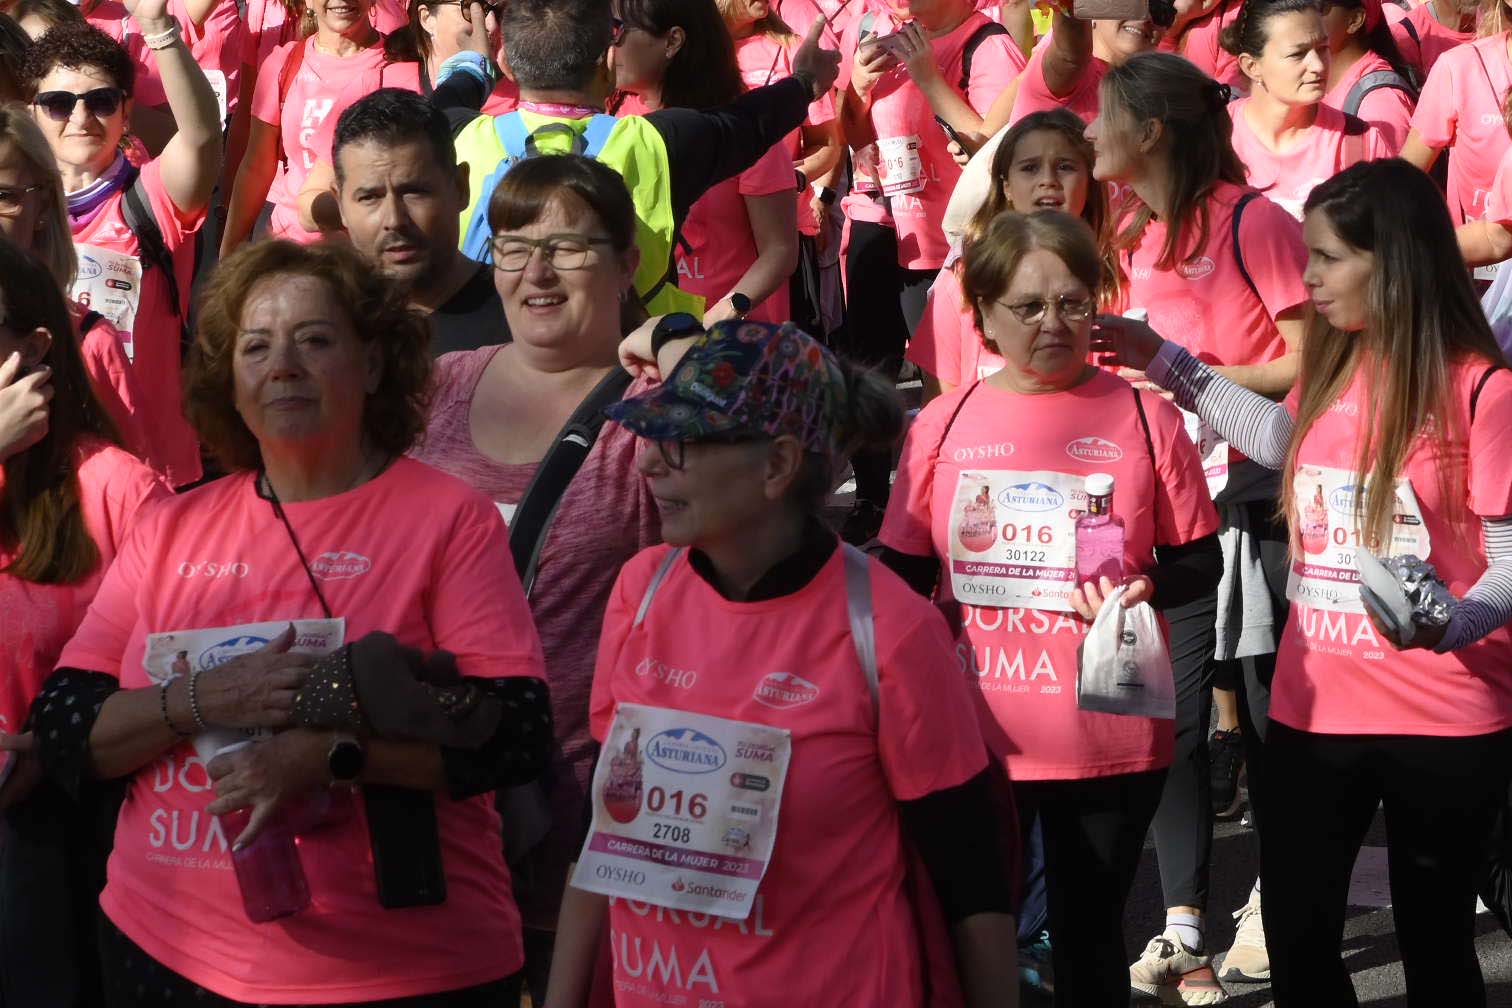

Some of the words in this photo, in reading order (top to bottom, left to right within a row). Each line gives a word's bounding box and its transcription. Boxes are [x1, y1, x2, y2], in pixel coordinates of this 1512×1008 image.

[954, 442, 1015, 462] OYSHO
[1001, 490, 1060, 507] ASTURIANA
[1002, 523, 1053, 544] 016
[1006, 548, 1046, 563] 30122
[965, 564, 1006, 576] CARRERA
[1008, 566, 1022, 576] DE
[1022, 566, 1034, 576] LA
[1035, 567, 1066, 579] MUJER
[962, 582, 1006, 596] OYSHO
[1362, 650, 1385, 661] 2023
[1040, 684, 1062, 694] 2023
[653, 740, 719, 767] ASTURIANA
[647, 786, 709, 820] 016
[652, 822, 691, 843] 2708
[607, 840, 652, 858] CARRERA
[651, 849, 664, 860] DE
[664, 851, 678, 863] LA
[680, 853, 718, 869] MUJER
[596, 863, 646, 886] OYSHO
[687, 879, 747, 902] Santander
